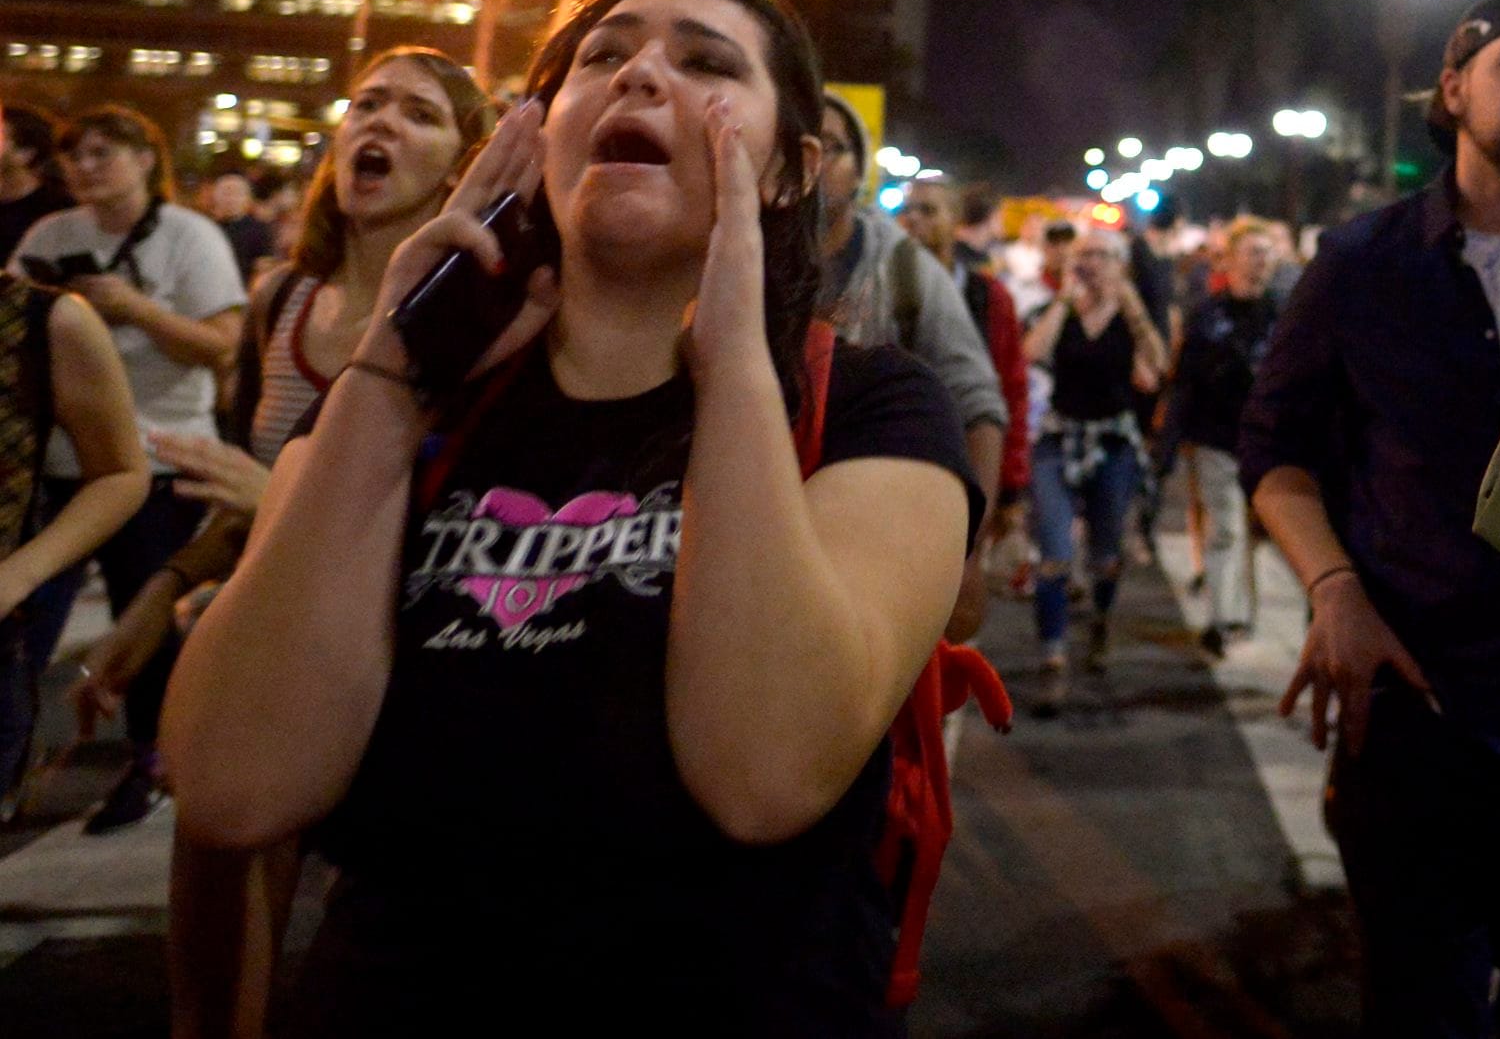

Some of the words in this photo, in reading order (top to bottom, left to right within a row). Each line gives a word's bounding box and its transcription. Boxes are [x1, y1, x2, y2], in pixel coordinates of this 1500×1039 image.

[420, 510, 684, 577] TRIPPER
[422, 617, 489, 649] Las
[498, 618, 587, 654] Vegas
